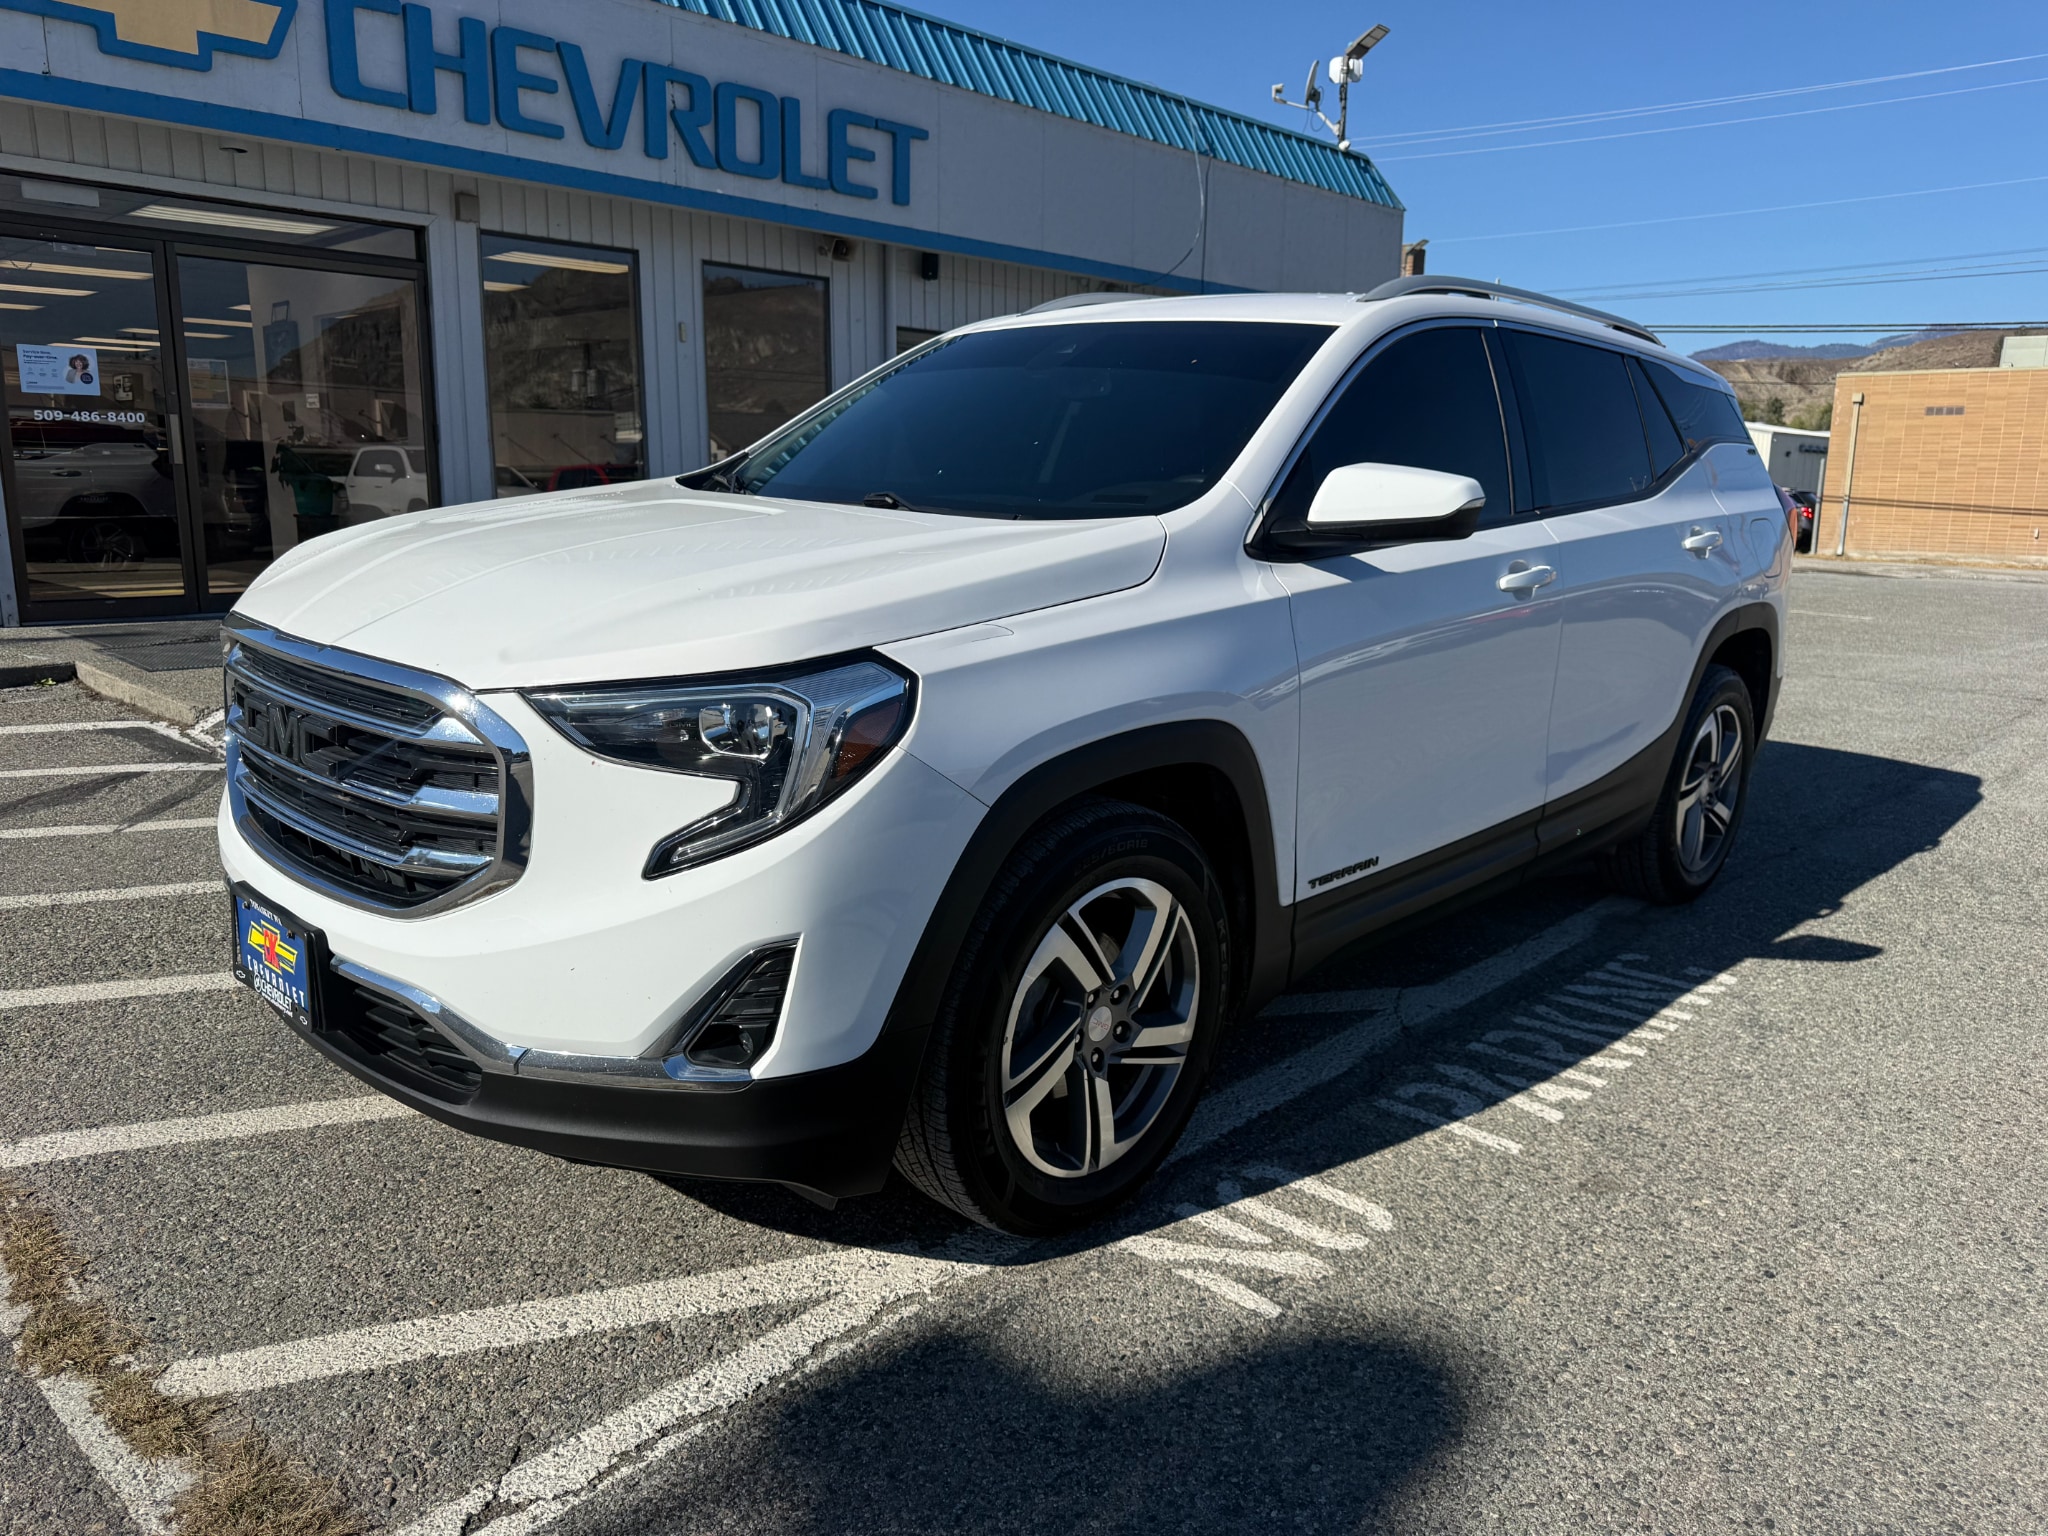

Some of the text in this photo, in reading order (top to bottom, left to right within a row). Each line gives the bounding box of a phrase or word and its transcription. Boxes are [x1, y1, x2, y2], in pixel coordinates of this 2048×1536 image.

[324, 0, 929, 206] CHEVROLET
[33, 409, 146, 424] 509-486-8400
[243, 690, 338, 778] GMC
[1308, 855, 1379, 889] TERRAIN
[247, 954, 305, 1008] CHEVROLET
[260, 978, 293, 1011] CHEVROLET
[1374, 952, 1739, 1155] PARKING
